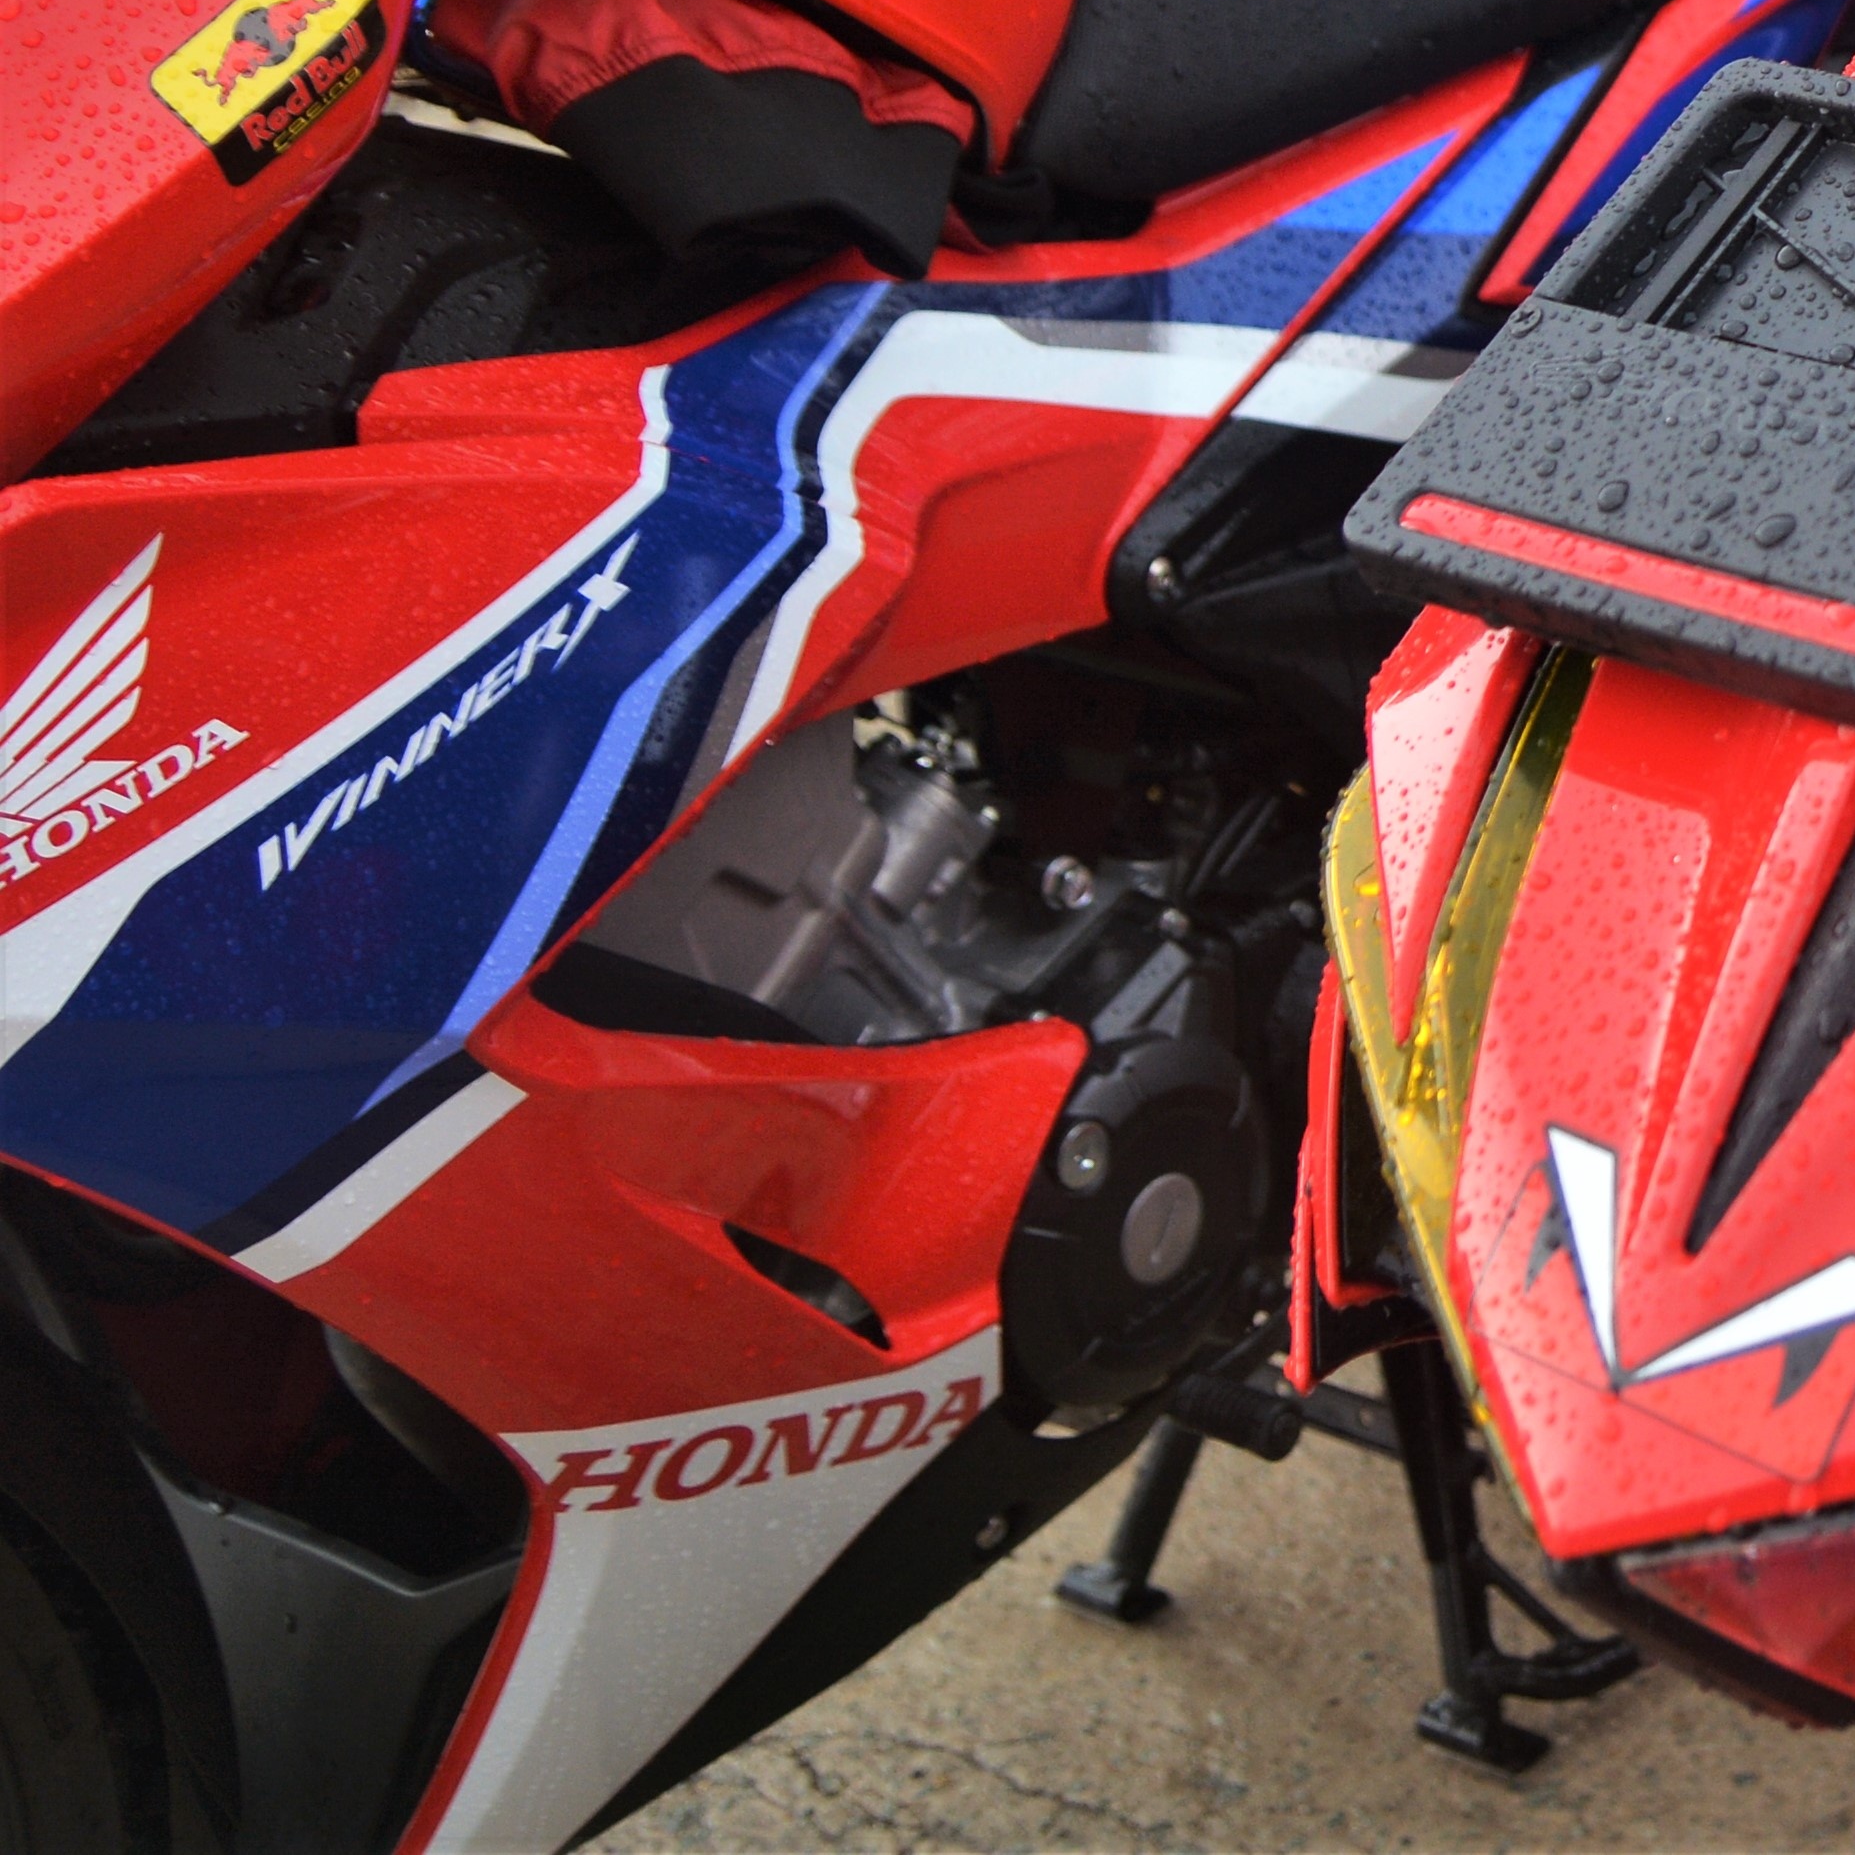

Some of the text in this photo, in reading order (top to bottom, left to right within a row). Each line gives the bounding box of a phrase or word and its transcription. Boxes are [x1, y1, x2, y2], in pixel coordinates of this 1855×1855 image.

[241, 20, 369, 152] Red Bull
[0, 718, 250, 892] HONDA
[544, 1375, 984, 1513] HONDA
